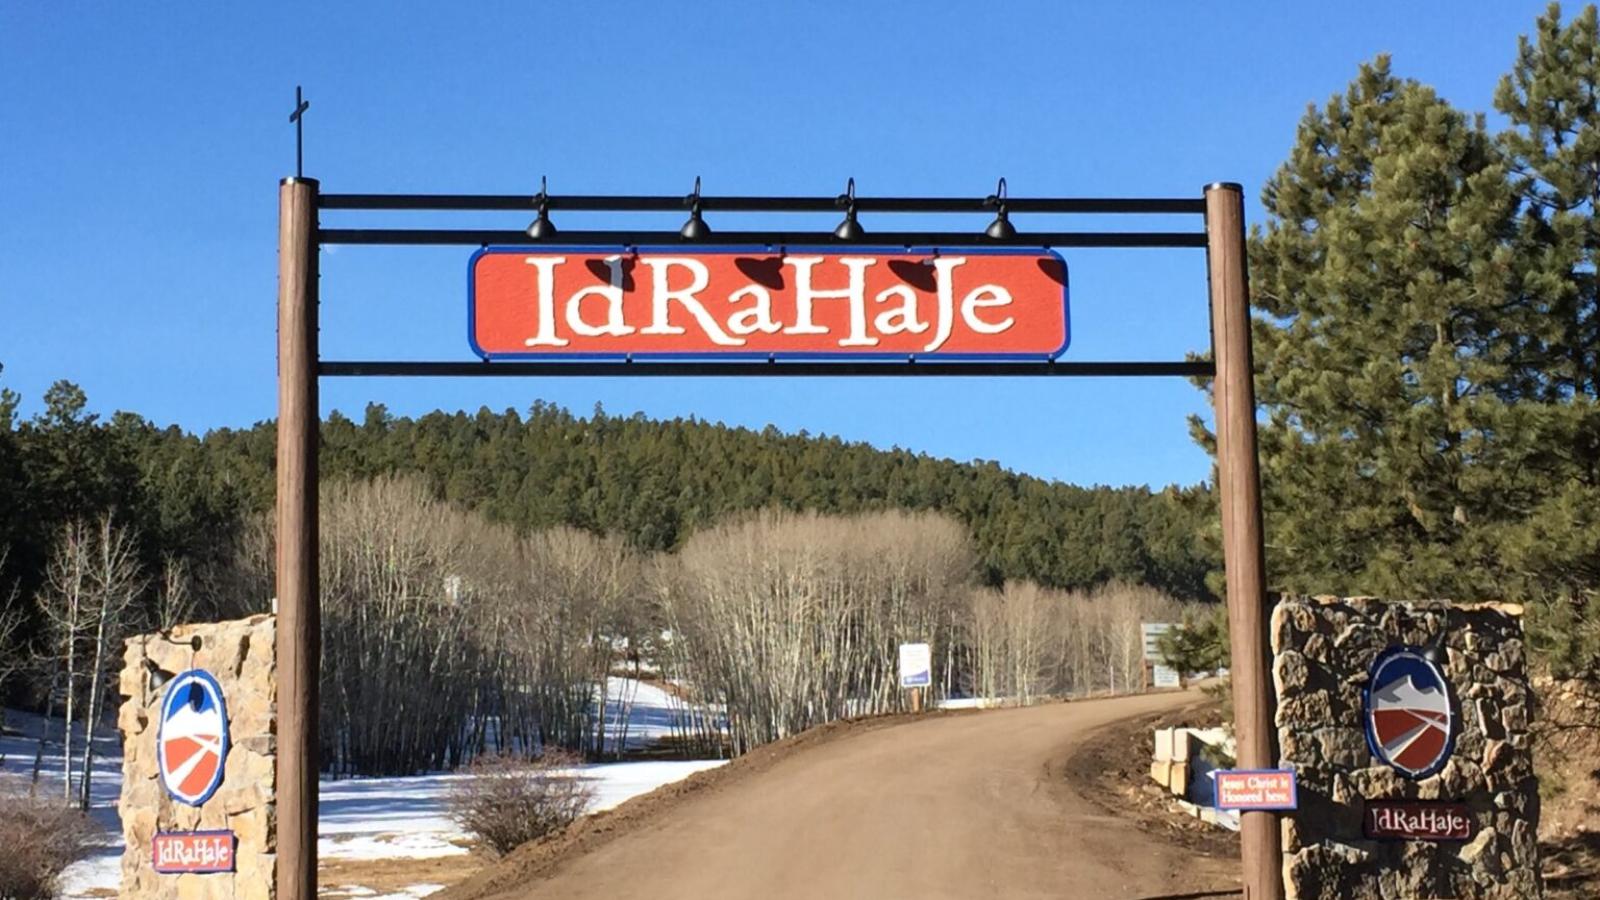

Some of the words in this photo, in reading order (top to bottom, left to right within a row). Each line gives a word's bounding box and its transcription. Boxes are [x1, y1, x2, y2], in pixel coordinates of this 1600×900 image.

[525, 256, 1016, 352] IdRaHaJe
[1222, 789, 1263, 803] Honored
[1247, 777, 1278, 789] Christ
[1371, 808, 1464, 836] IdRaHaJe
[157, 839, 229, 867] IdRaHaJe
